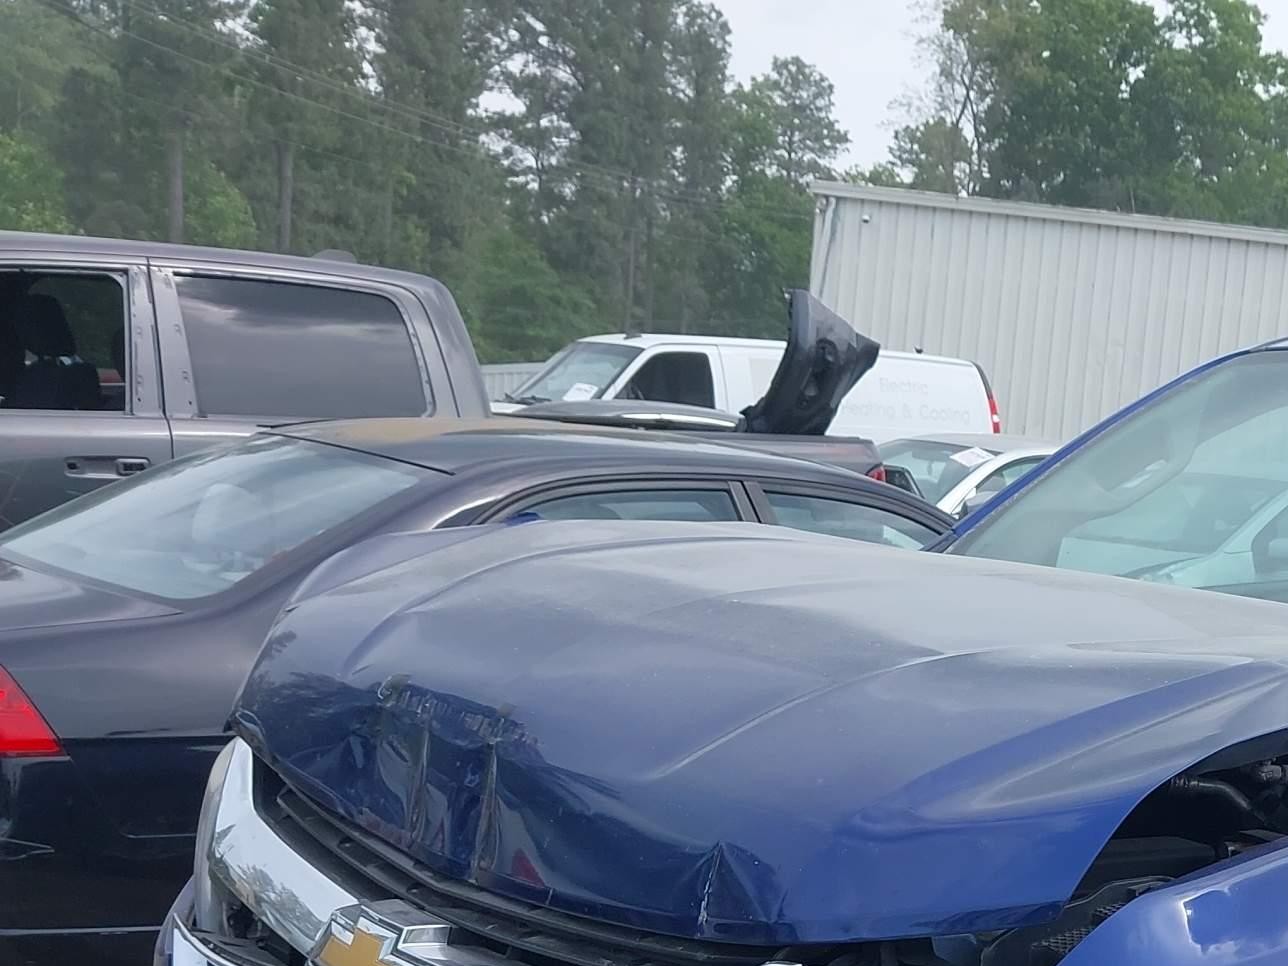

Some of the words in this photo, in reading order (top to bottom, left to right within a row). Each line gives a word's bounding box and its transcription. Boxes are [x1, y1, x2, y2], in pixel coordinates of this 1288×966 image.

[880, 377, 928, 393] Electric
[902, 402, 912, 418] &
[919, 403, 970, 424] Cooling
